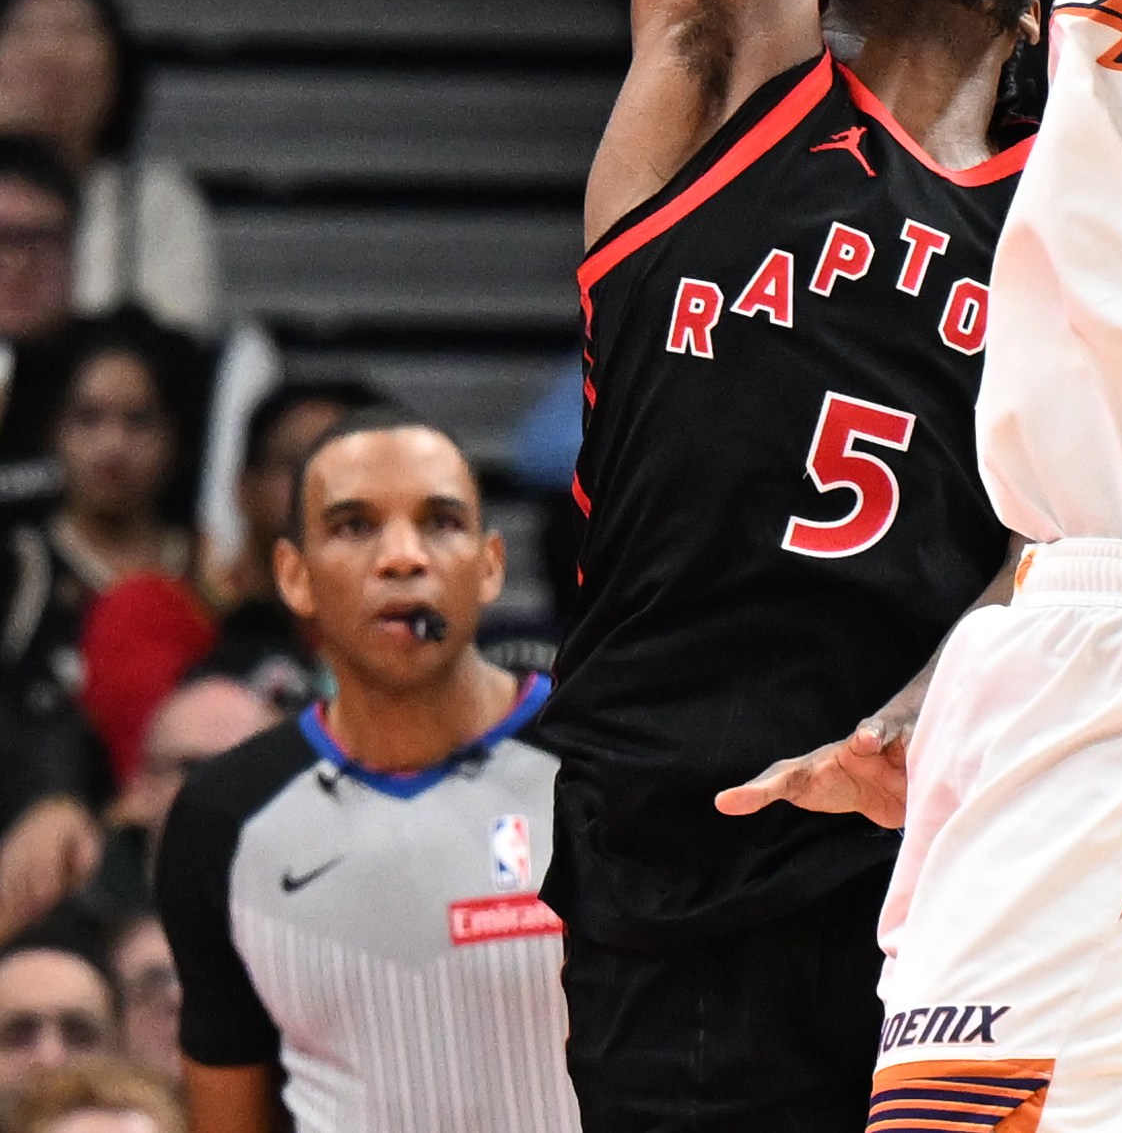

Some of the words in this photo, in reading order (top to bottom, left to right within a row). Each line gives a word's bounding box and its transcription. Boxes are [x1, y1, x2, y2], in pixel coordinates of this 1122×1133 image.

[665, 218, 990, 359] RAPTO
[781, 390, 916, 558] 5
[879, 1005, 1012, 1054] OENIX
